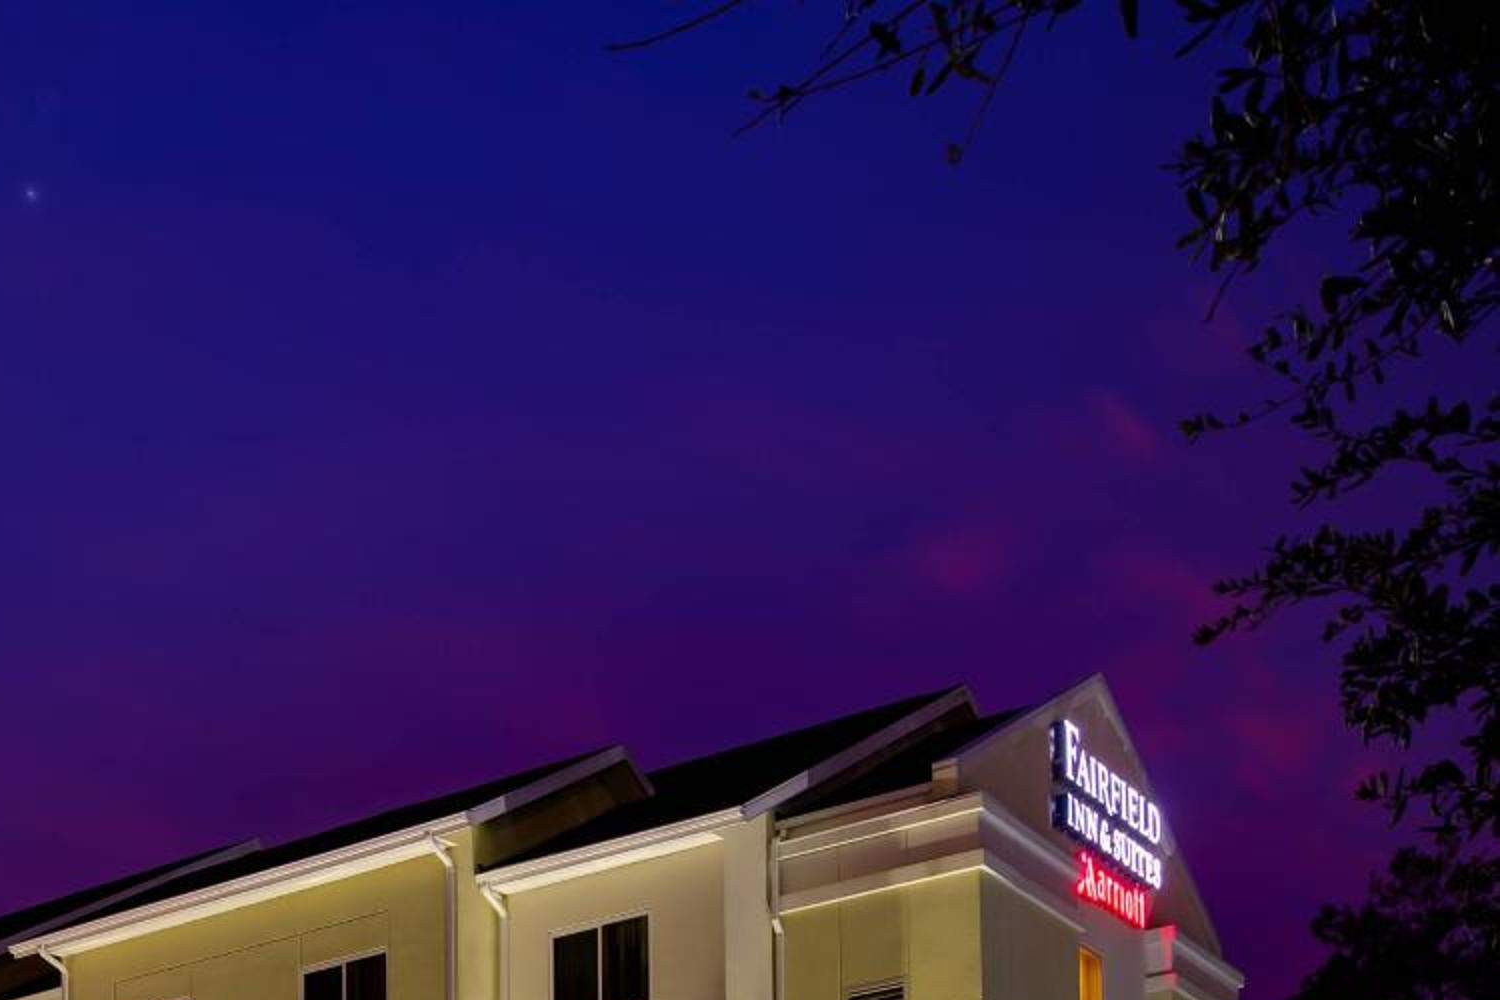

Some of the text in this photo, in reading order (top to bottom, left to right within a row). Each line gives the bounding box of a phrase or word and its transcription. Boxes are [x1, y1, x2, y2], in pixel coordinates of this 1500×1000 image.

[1064, 719, 1161, 844] FAIRFIELD
[1067, 792, 1161, 889] INN & SUITES
[1077, 852, 1145, 929] Marriott
